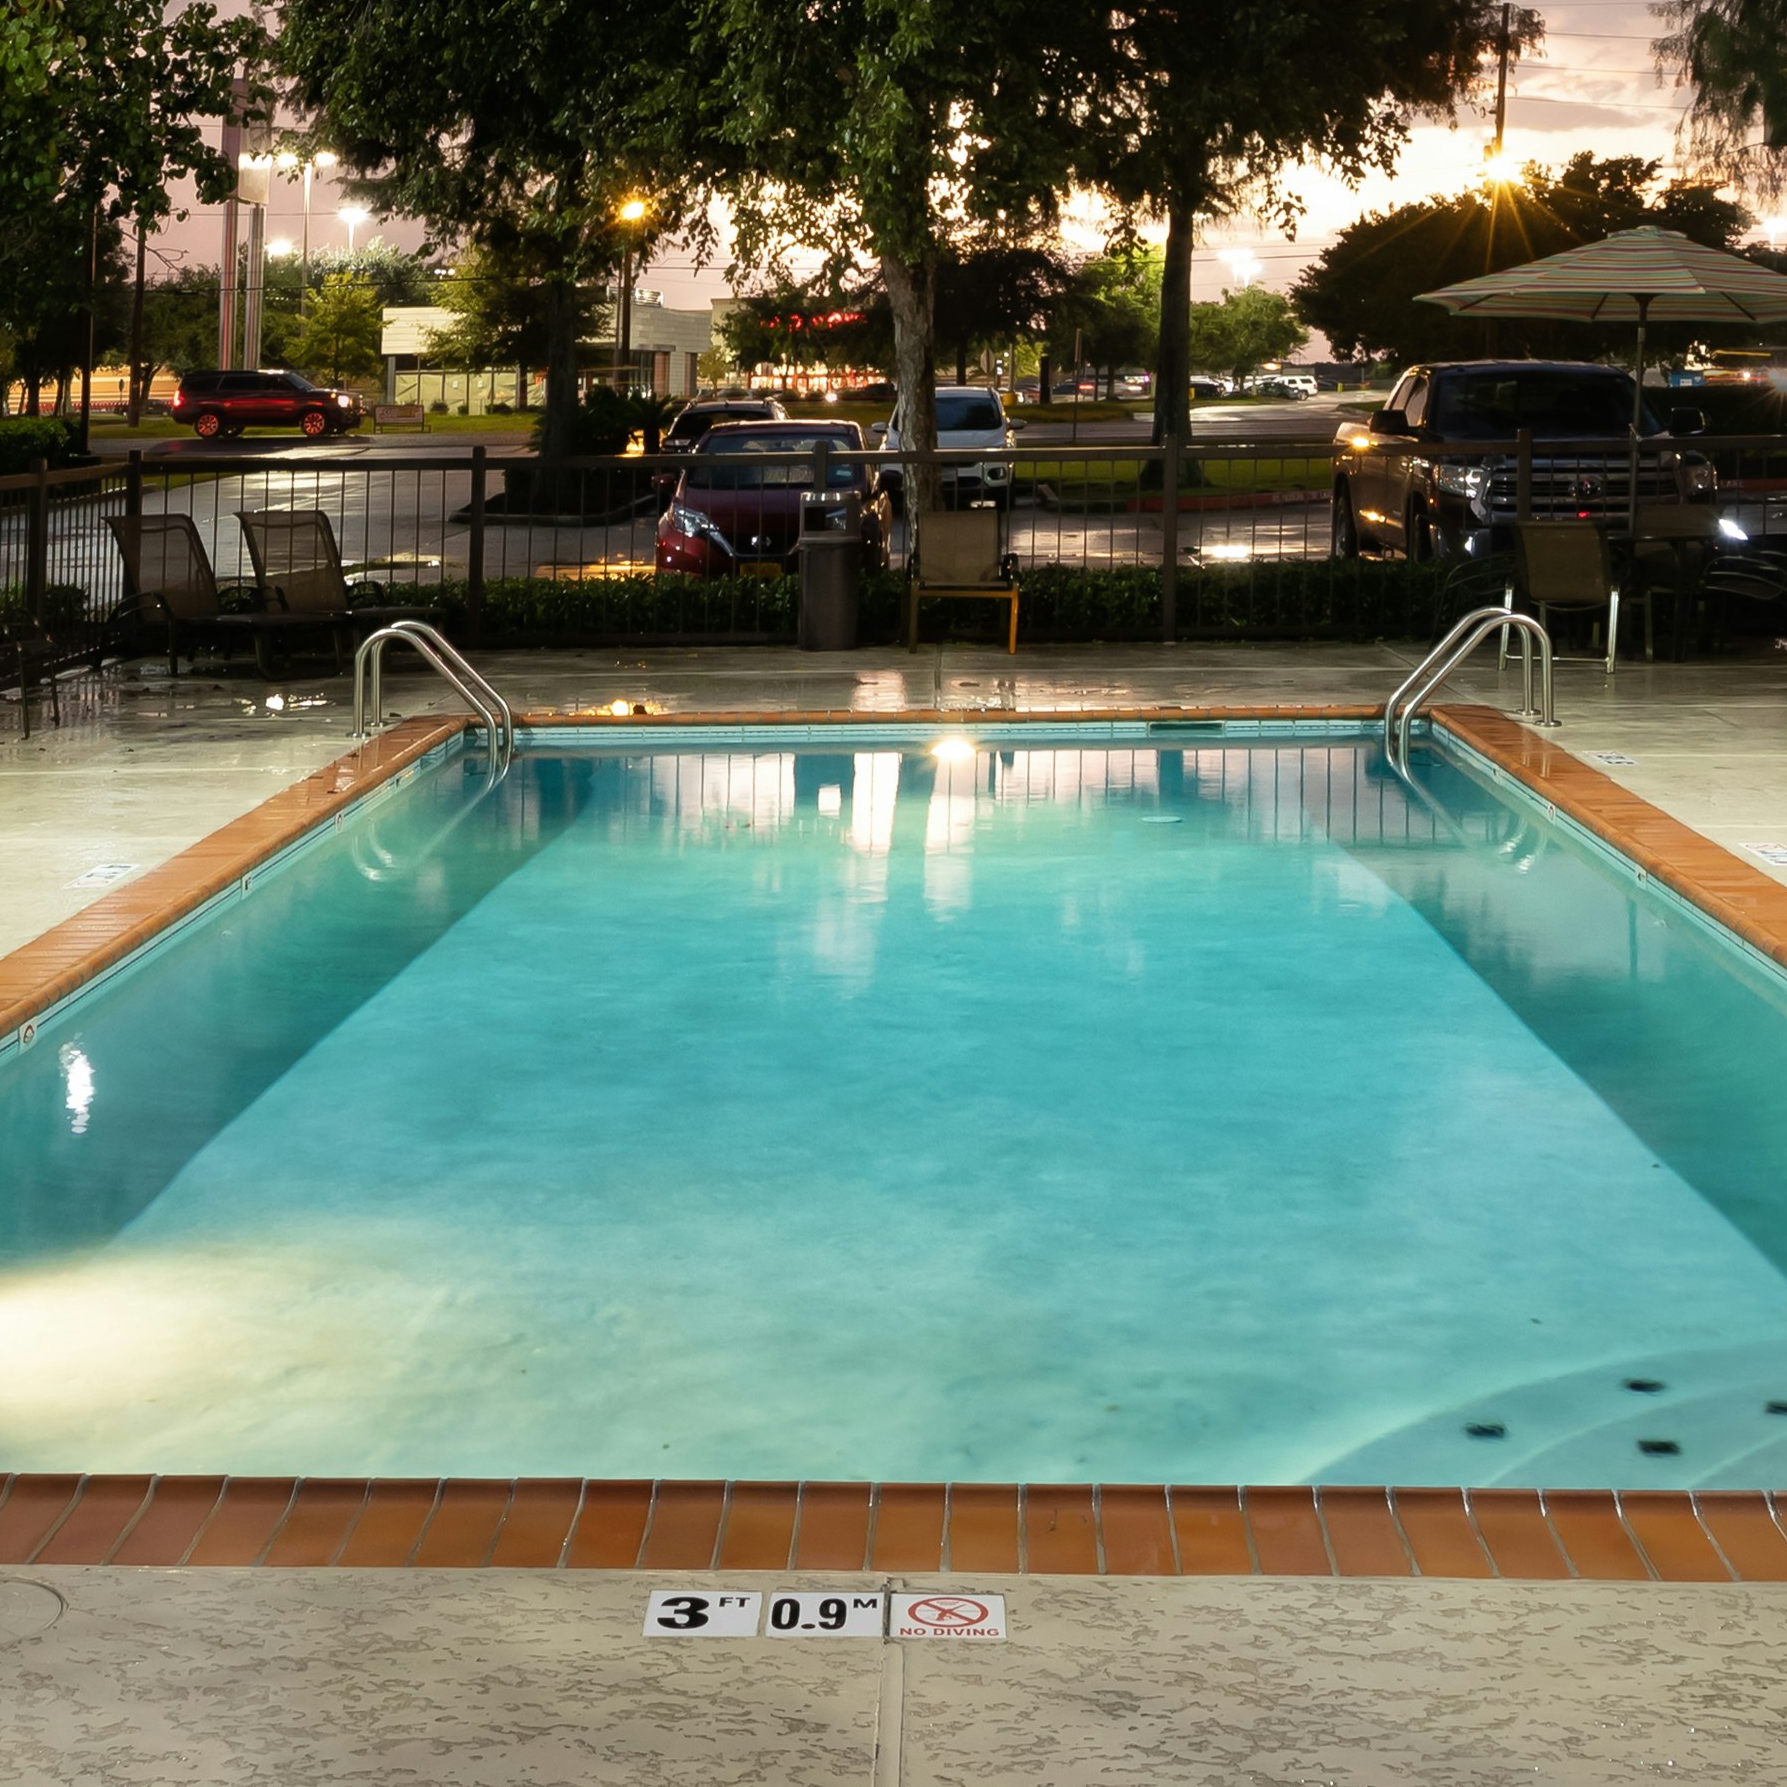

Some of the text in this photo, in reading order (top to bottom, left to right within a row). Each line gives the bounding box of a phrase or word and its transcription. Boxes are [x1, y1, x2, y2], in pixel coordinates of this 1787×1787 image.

[657, 1596, 751, 1630] 3 FT
[771, 1598, 878, 1630] 0.9 M
[900, 1627, 999, 1636] NO DIVING
